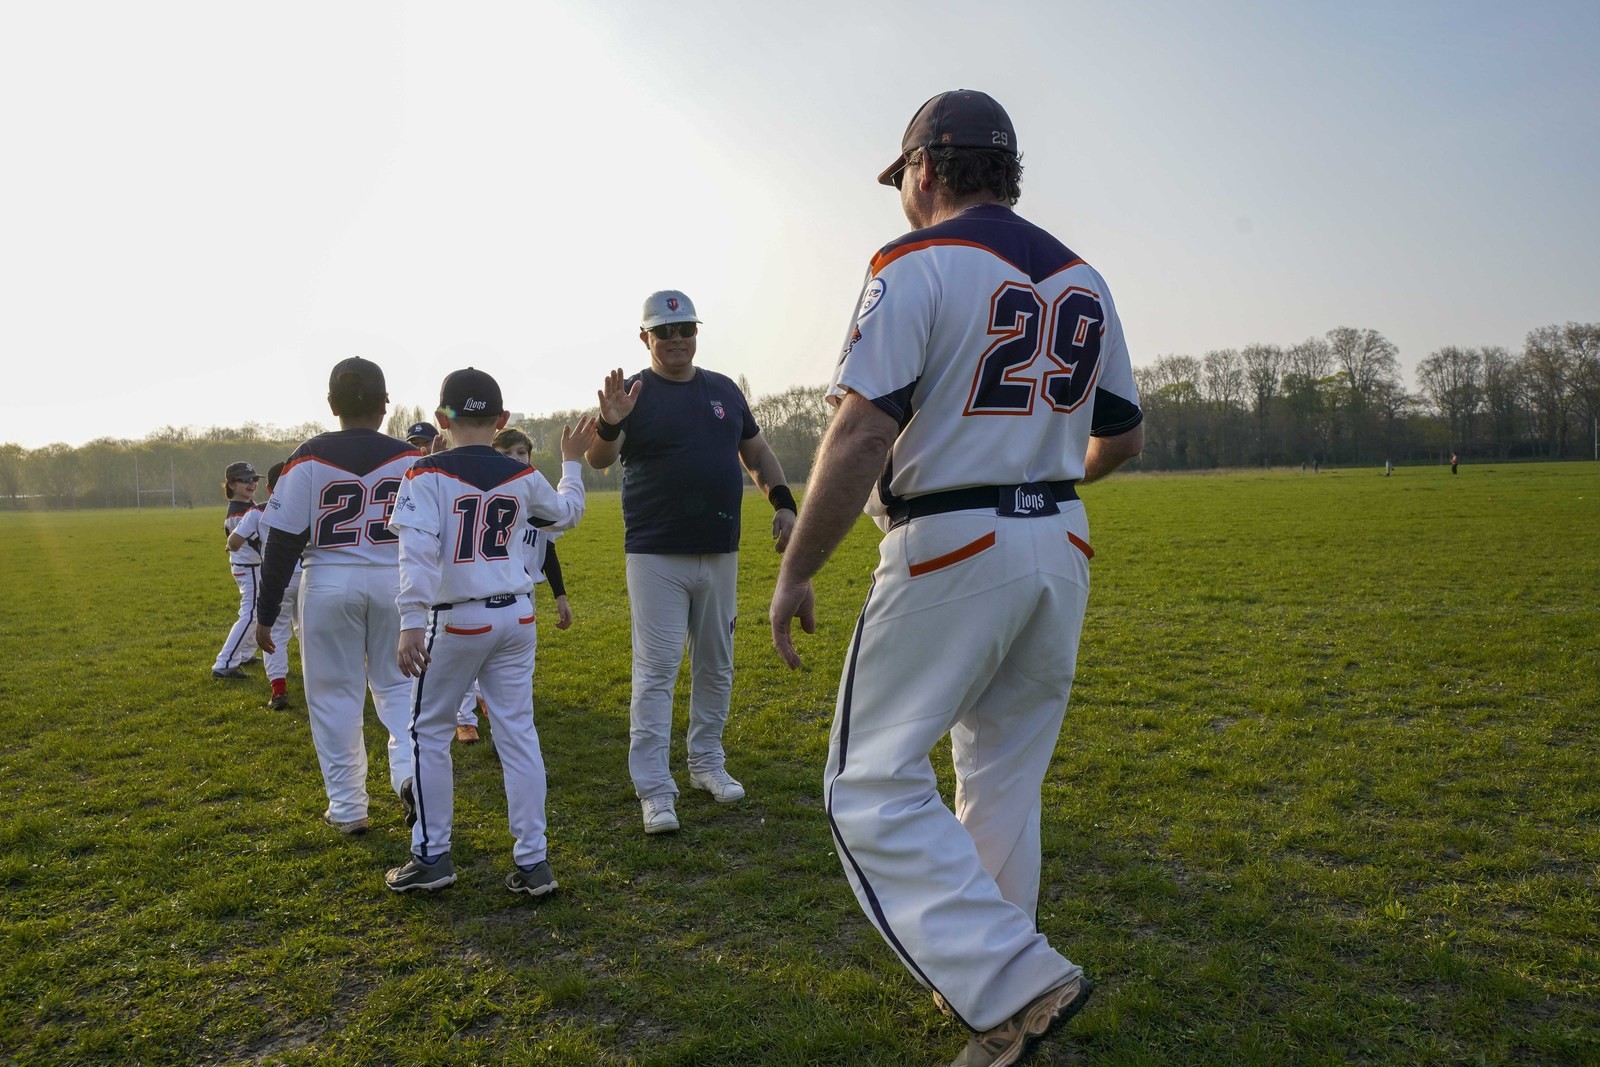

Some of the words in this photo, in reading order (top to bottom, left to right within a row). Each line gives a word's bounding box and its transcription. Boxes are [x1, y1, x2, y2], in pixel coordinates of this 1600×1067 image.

[991, 130, 1008, 146] 29
[962, 280, 1106, 416] 29
[463, 396, 487, 411] Lions
[314, 477, 402, 548] 23
[1014, 485, 1045, 514] Lions
[453, 494, 520, 563] 18
